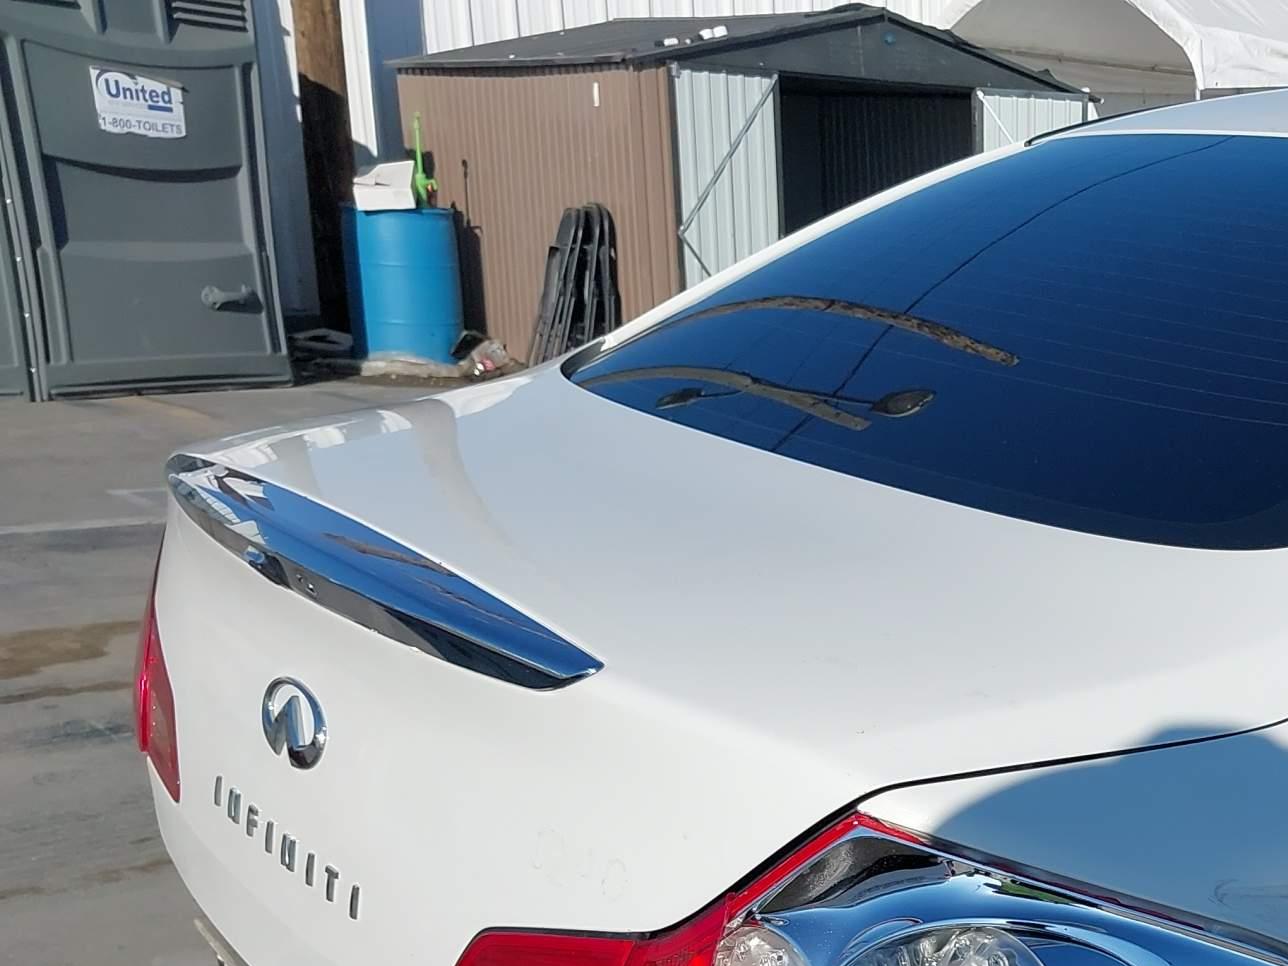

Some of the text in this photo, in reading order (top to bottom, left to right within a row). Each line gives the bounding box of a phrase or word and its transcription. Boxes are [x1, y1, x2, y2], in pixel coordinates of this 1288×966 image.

[103, 78, 173, 105] United
[101, 116, 183, 135] 1-800-TOILETS
[213, 775, 361, 920] INFINITI
